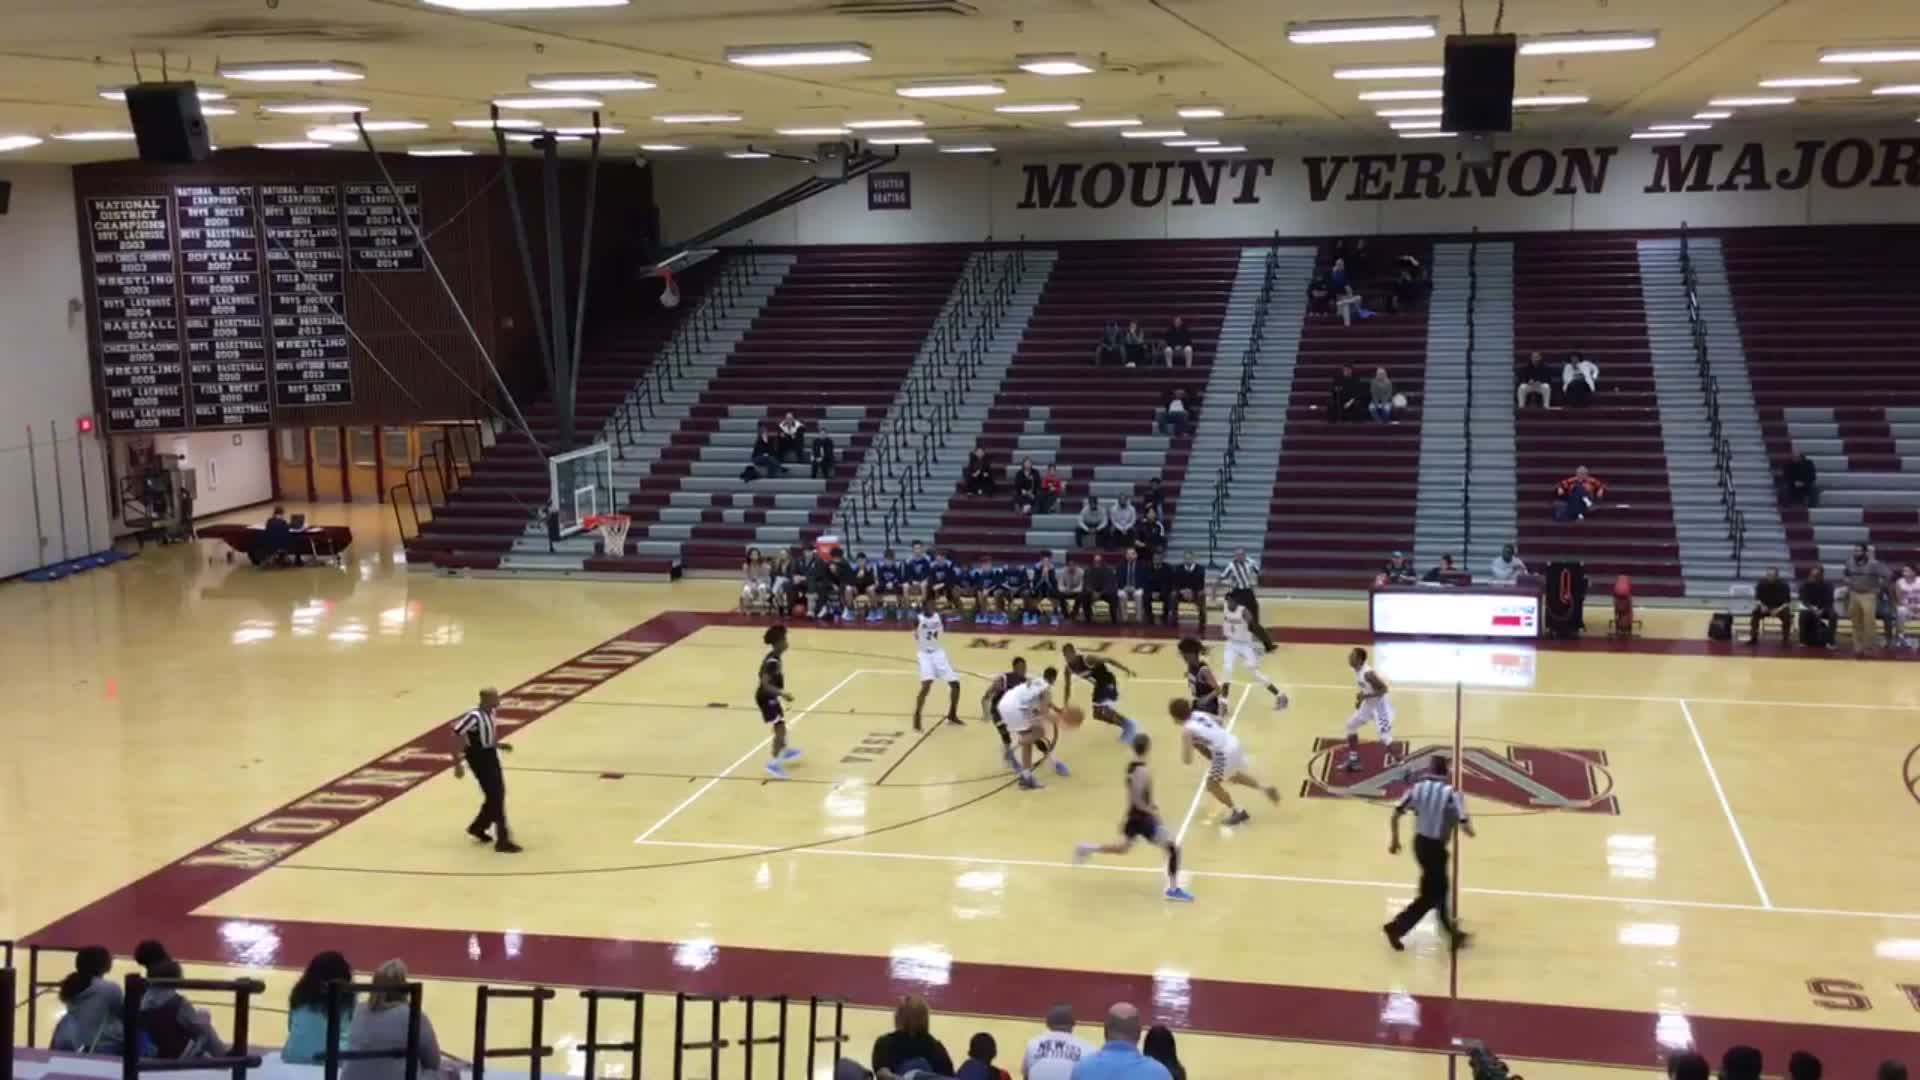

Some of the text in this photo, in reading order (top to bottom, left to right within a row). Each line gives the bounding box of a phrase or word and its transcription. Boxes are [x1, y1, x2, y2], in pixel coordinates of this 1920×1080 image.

[1017, 158, 1274, 210] MOUNT
[1302, 145, 1618, 202] VERNON
[96, 200, 160, 209] NATIONAL
[100, 210, 157, 220] DISTRICT
[94, 220, 165, 230] CHAMPIONS
[267, 228, 338, 238] WRESTLING
[187, 252, 253, 262] SOFTBALL
[98, 276, 173, 285] WRESTLING
[104, 320, 176, 331] BASEBALL
[276, 339, 346, 349] WRESTLING
[105, 365, 181, 376] WRESTLING
[969, 637, 1164, 655] MAJO
[180, 640, 668, 869] MOUNT ERNON
